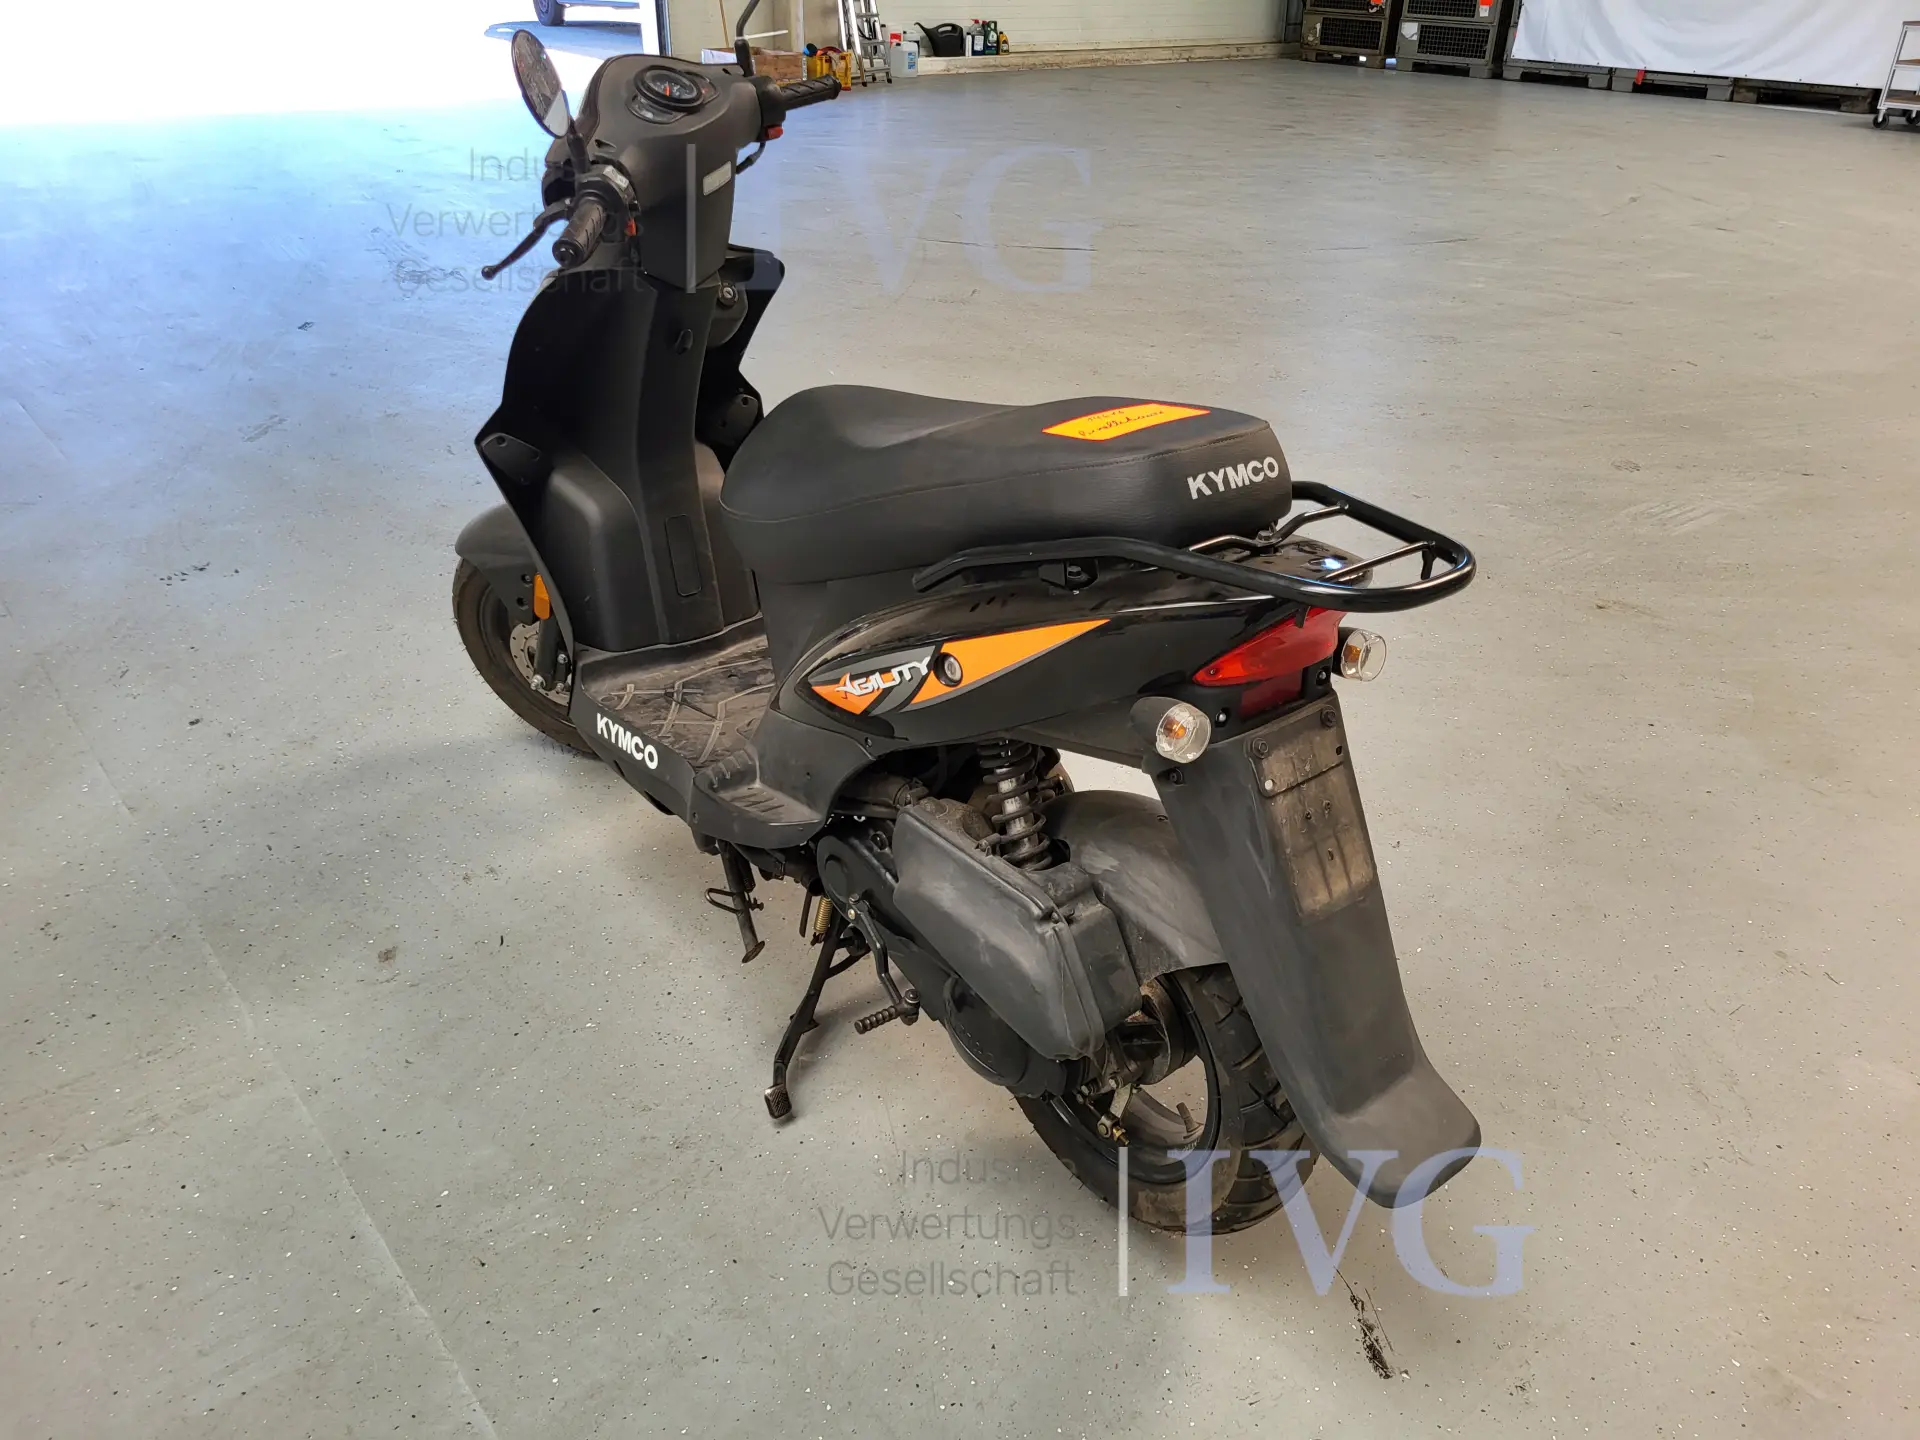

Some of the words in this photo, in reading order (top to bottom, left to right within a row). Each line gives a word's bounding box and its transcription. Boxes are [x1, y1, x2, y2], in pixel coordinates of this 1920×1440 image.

[1187, 456, 1280, 501] KYMCO
[835, 655, 932, 697] AGILITY
[596, 712, 659, 770] KYMCO
